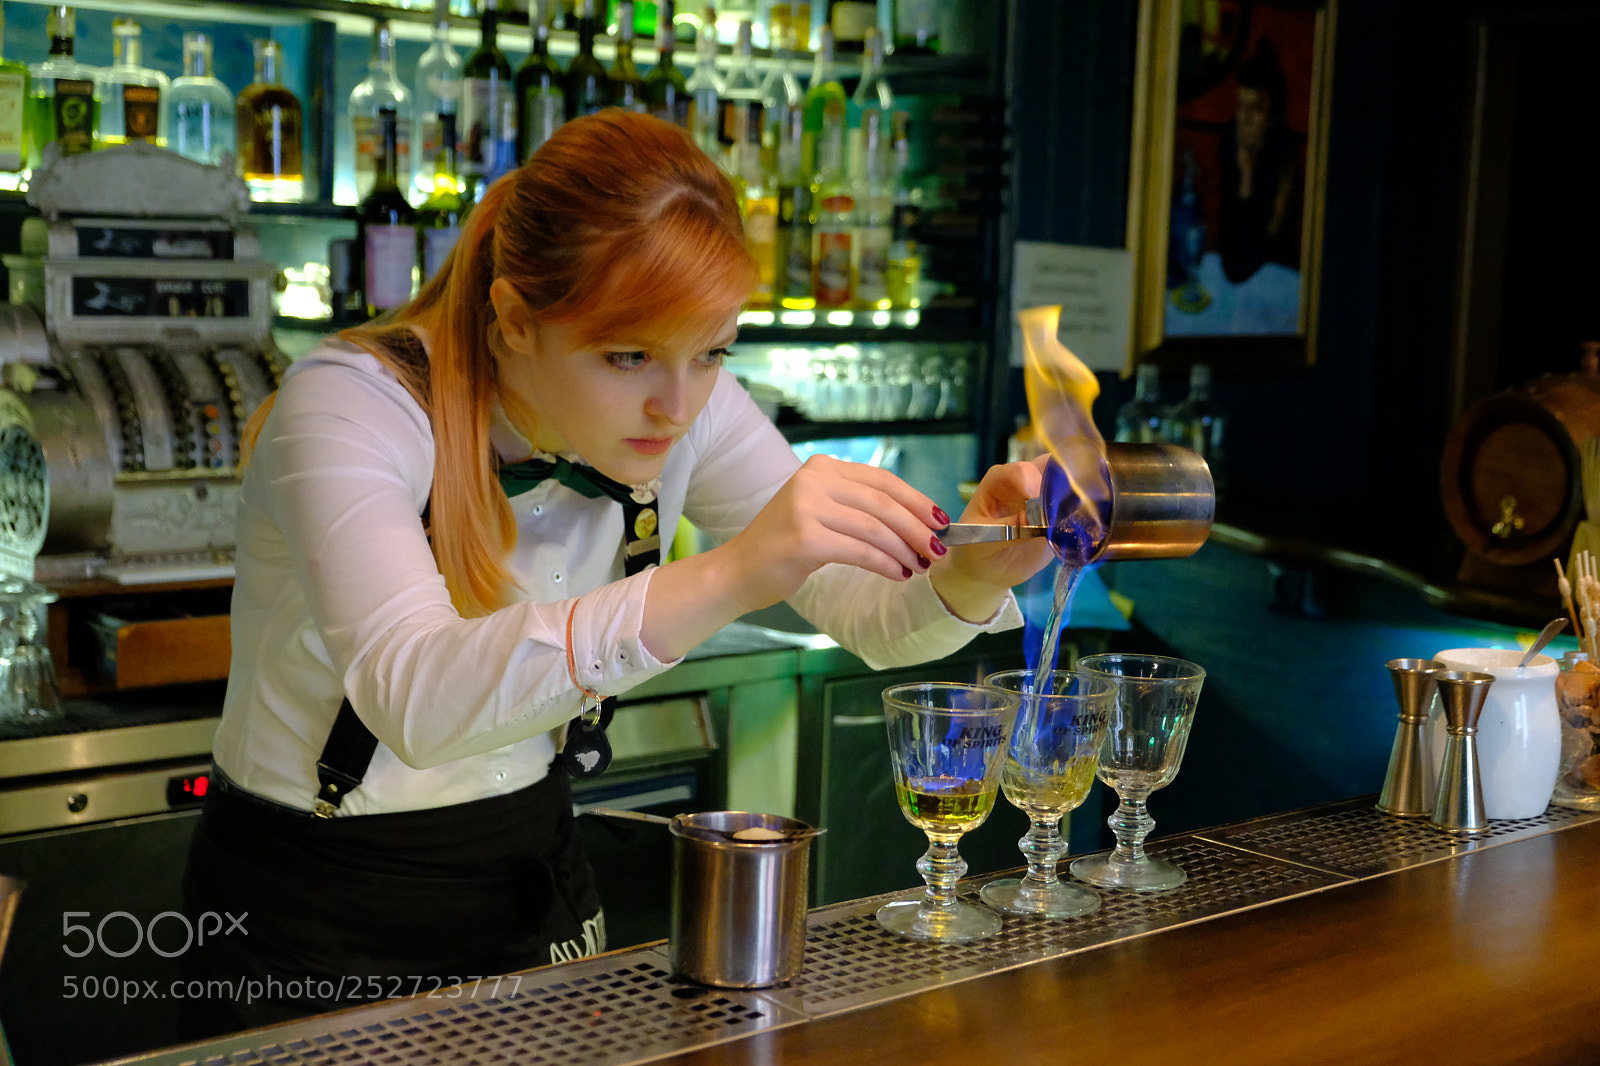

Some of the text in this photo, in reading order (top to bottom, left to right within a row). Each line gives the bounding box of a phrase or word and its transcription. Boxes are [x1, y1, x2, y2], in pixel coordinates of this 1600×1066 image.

[1070, 710, 1106, 727] KING
[960, 724, 1003, 739] KING
[1053, 726, 1071, 736] OF
[941, 738, 962, 748] OF
